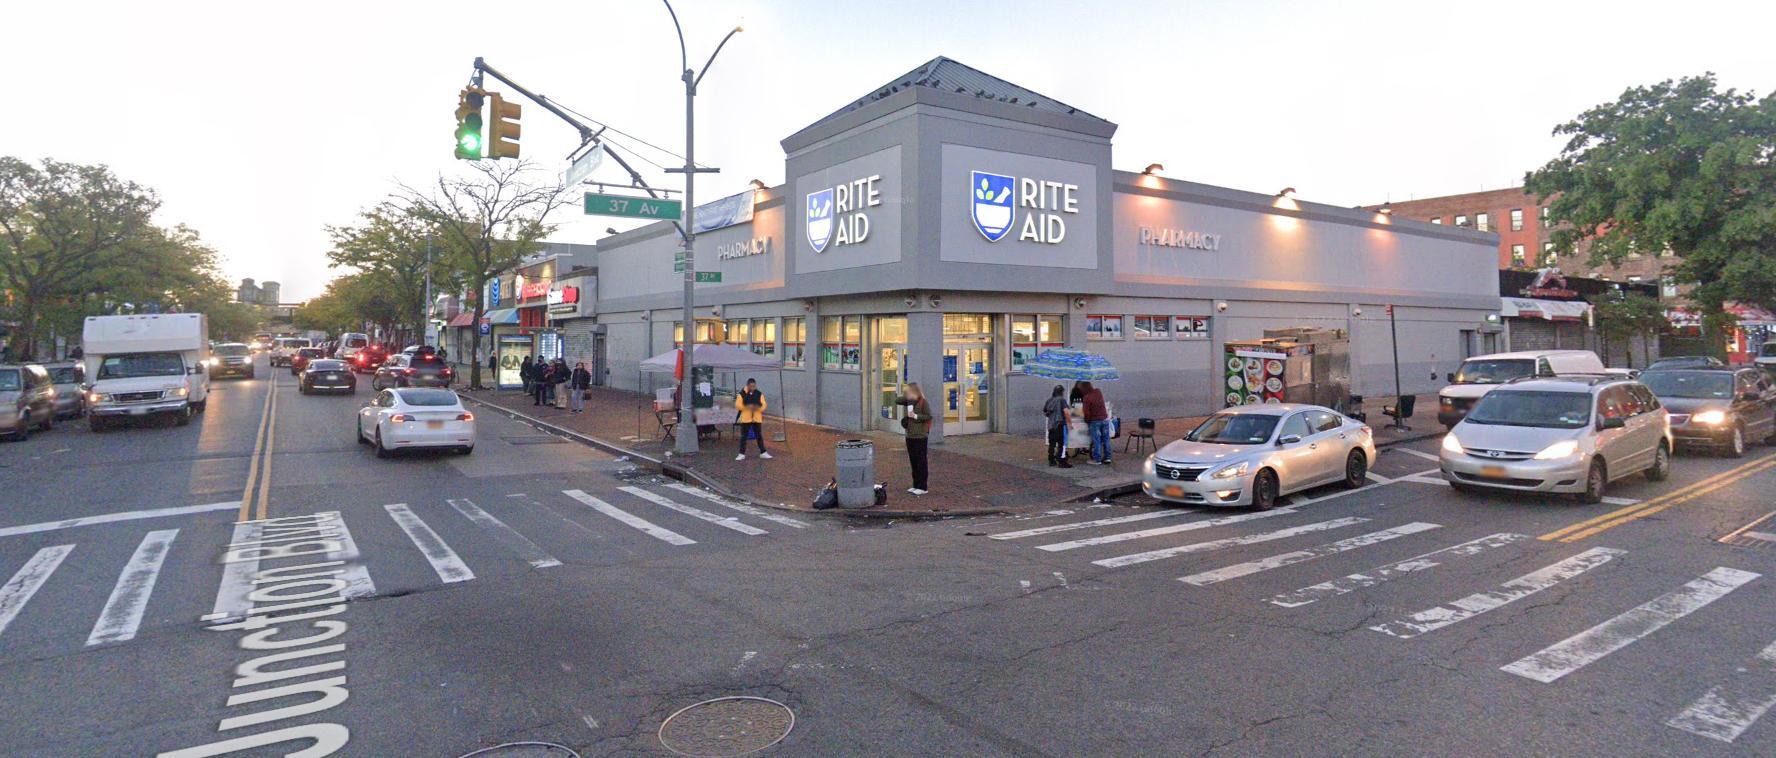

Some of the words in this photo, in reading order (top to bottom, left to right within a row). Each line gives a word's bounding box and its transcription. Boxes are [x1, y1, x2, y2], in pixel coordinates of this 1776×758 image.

[609, 200, 628, 212] 37
[640, 203, 659, 215] Av
[836, 175, 880, 213] RITE
[1021, 177, 1079, 213] RITE
[835, 212, 869, 247] AID
[1020, 212, 1065, 244] AID
[1140, 226, 1220, 251] PHARMACY
[718, 236, 768, 259] PHARMACY
